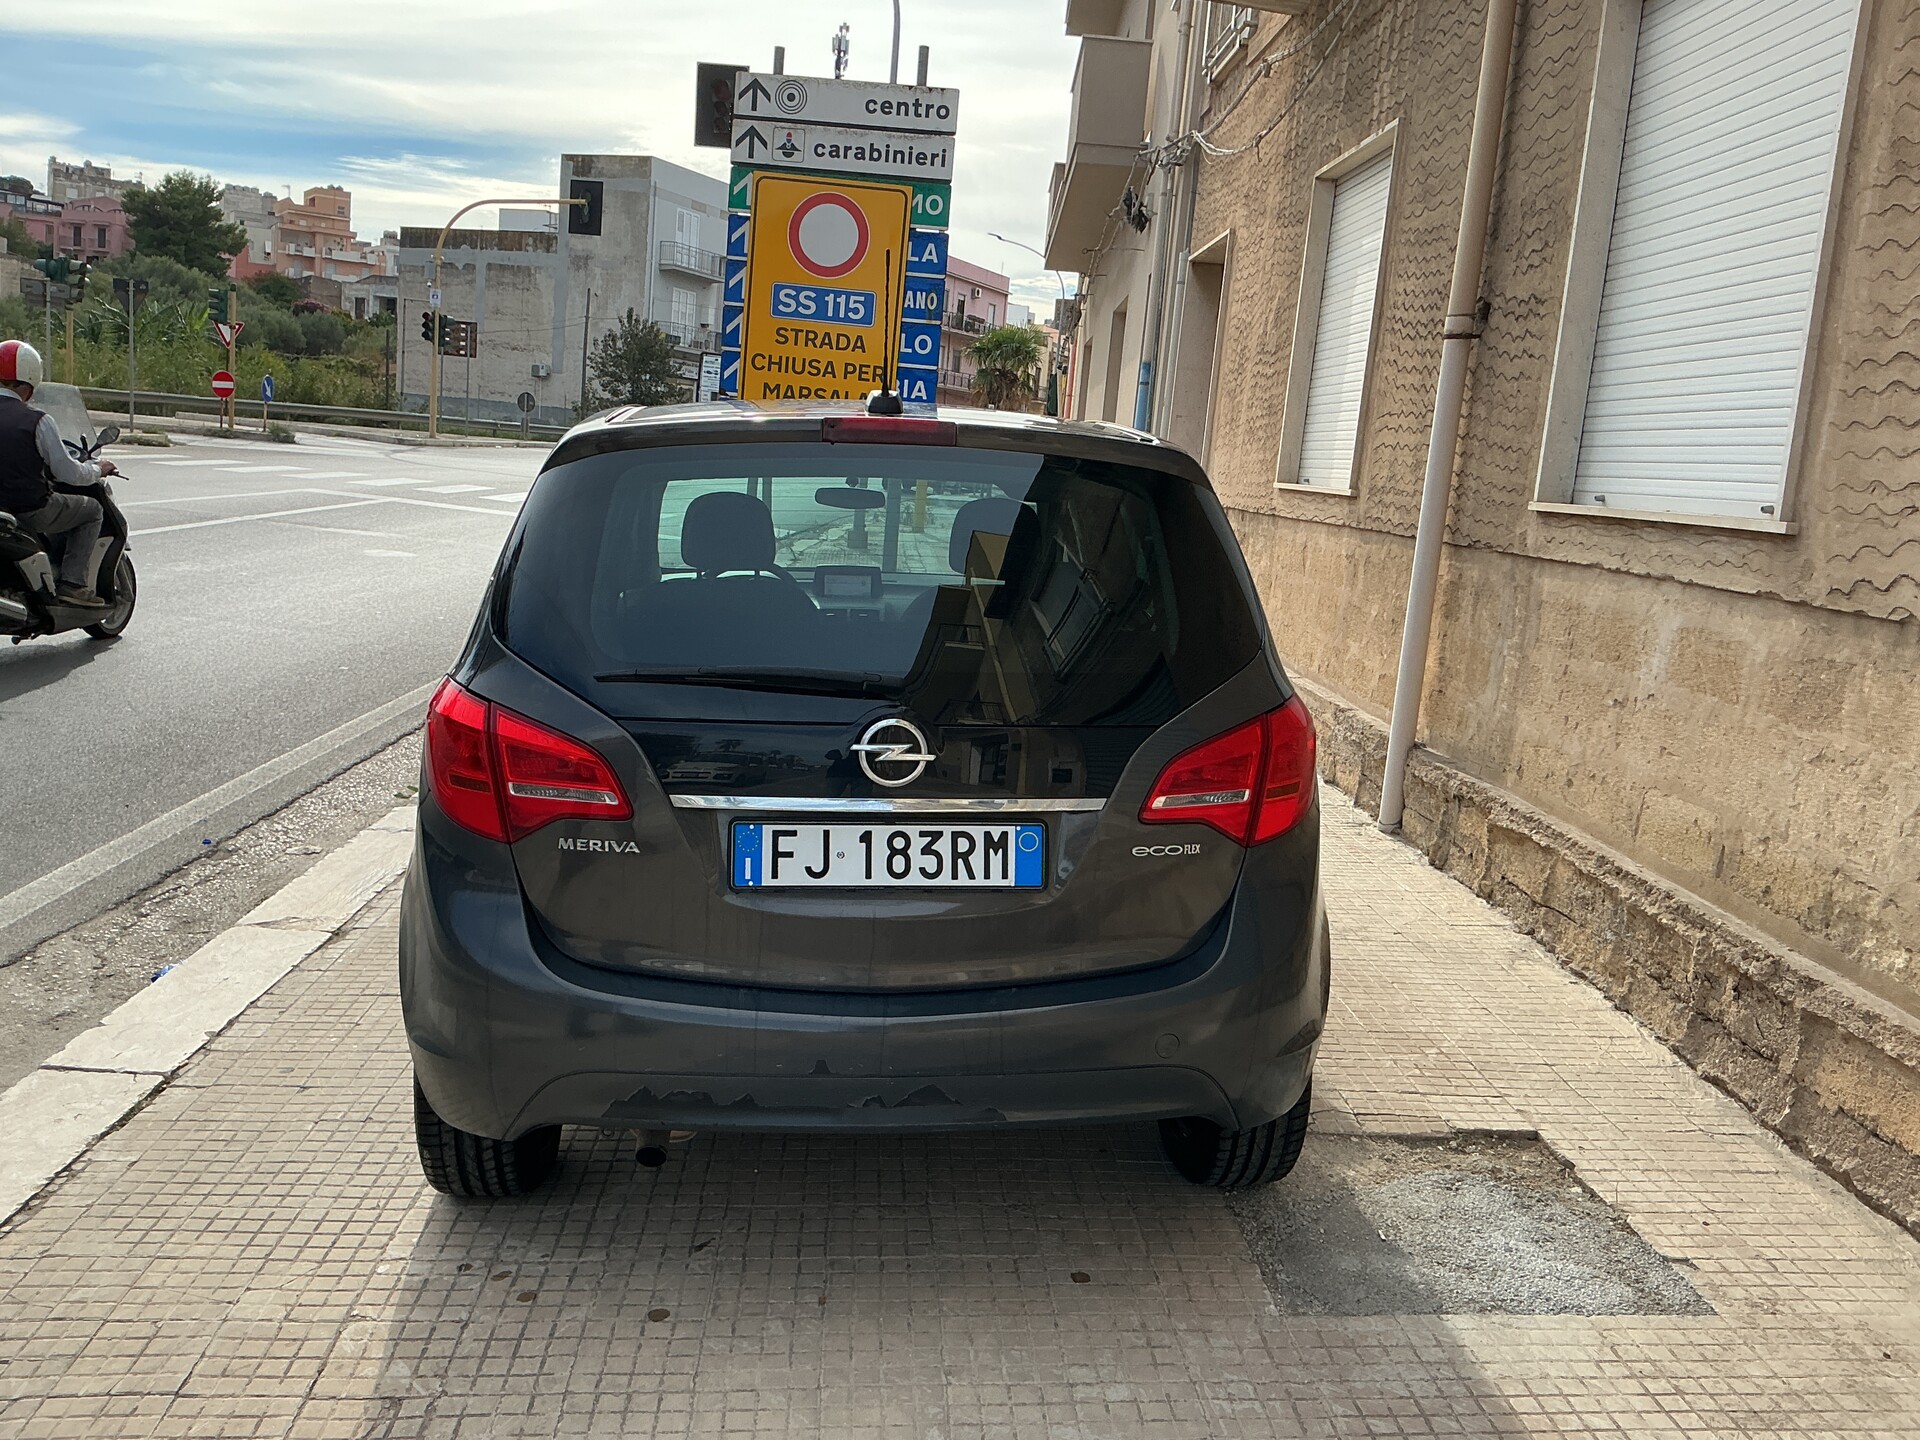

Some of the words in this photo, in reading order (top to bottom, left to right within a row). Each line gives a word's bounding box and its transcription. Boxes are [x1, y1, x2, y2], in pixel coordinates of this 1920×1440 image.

[865, 98, 950, 119] centro
[813, 142, 947, 168] carabinieri
[777, 288, 816, 315] SS
[824, 293, 865, 320] 115
[904, 290, 938, 310] ANO
[774, 326, 867, 353] STRADA
[900, 333, 932, 355] LO
[751, 352, 837, 379] CHIUSA
[843, 362, 883, 384] PER
[558, 837, 641, 854] MERIVA
[770, 829, 831, 880] FJ
[858, 829, 1010, 881] 183RM
